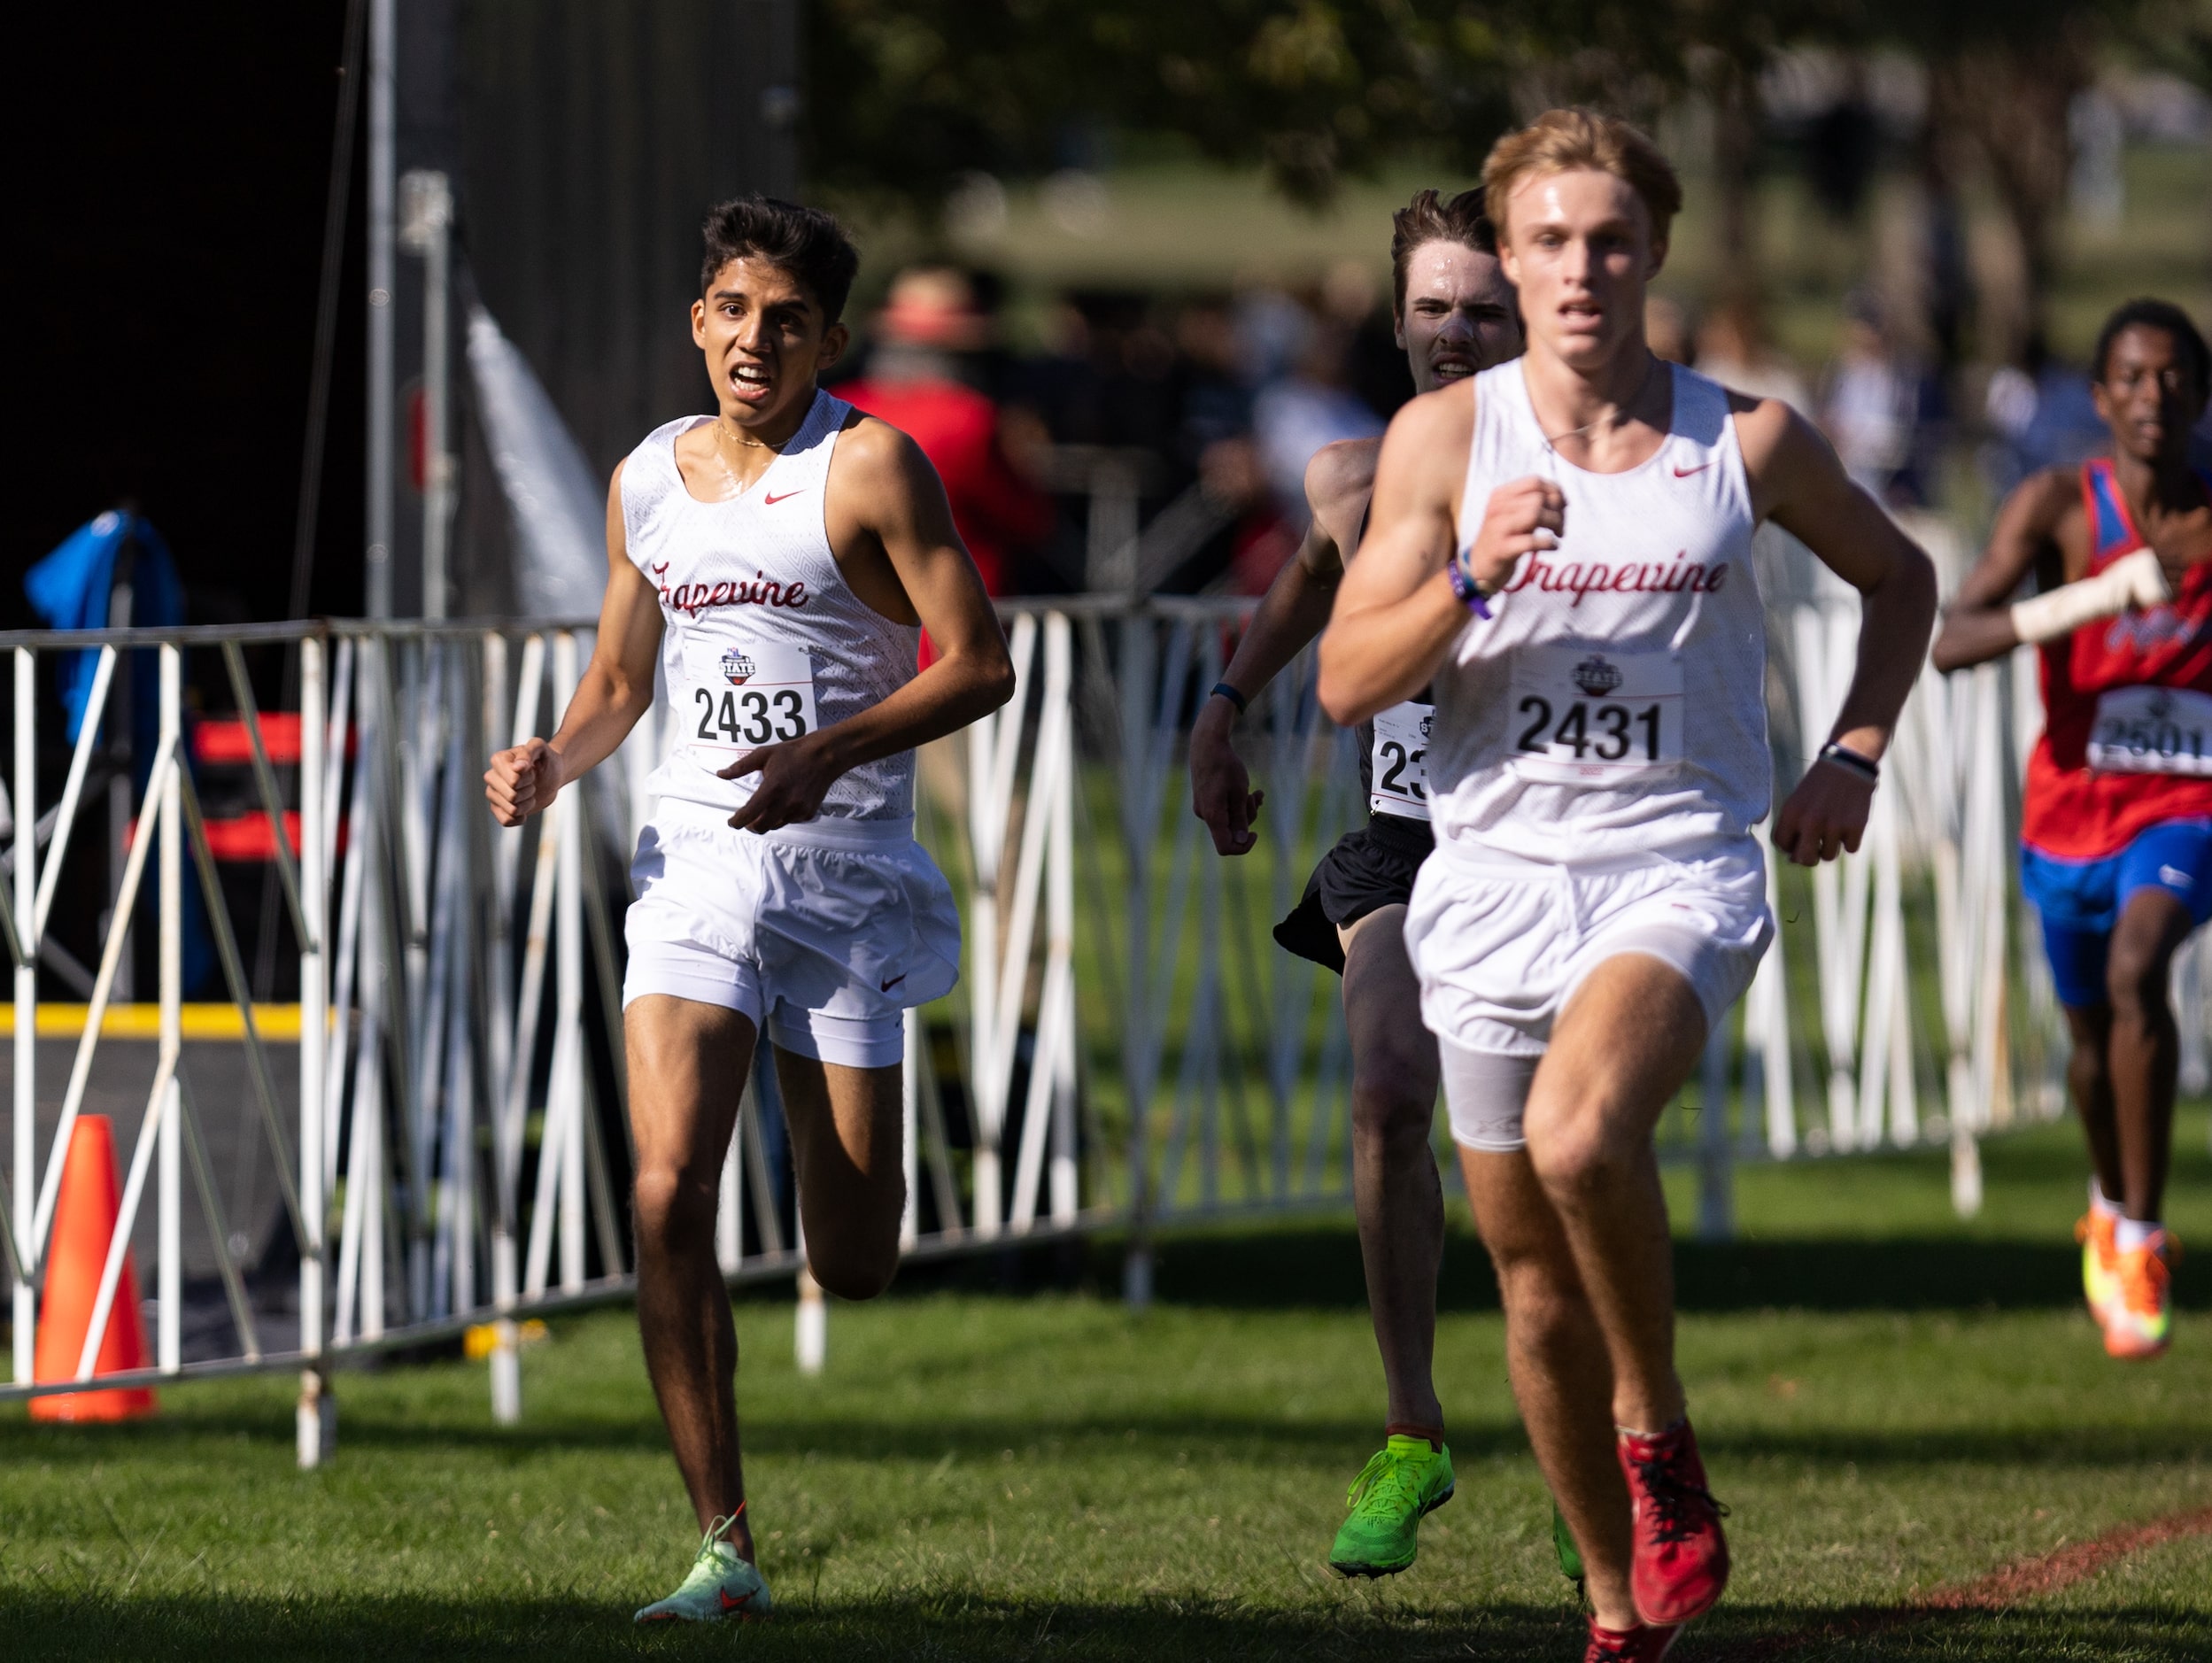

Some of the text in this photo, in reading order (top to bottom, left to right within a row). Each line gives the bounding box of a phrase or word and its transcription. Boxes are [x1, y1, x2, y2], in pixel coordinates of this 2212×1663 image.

[718, 661, 755, 674] STATE
[695, 688, 807, 744] 2433
[1518, 695, 1661, 761] 2431
[1380, 741, 1428, 801] 23
